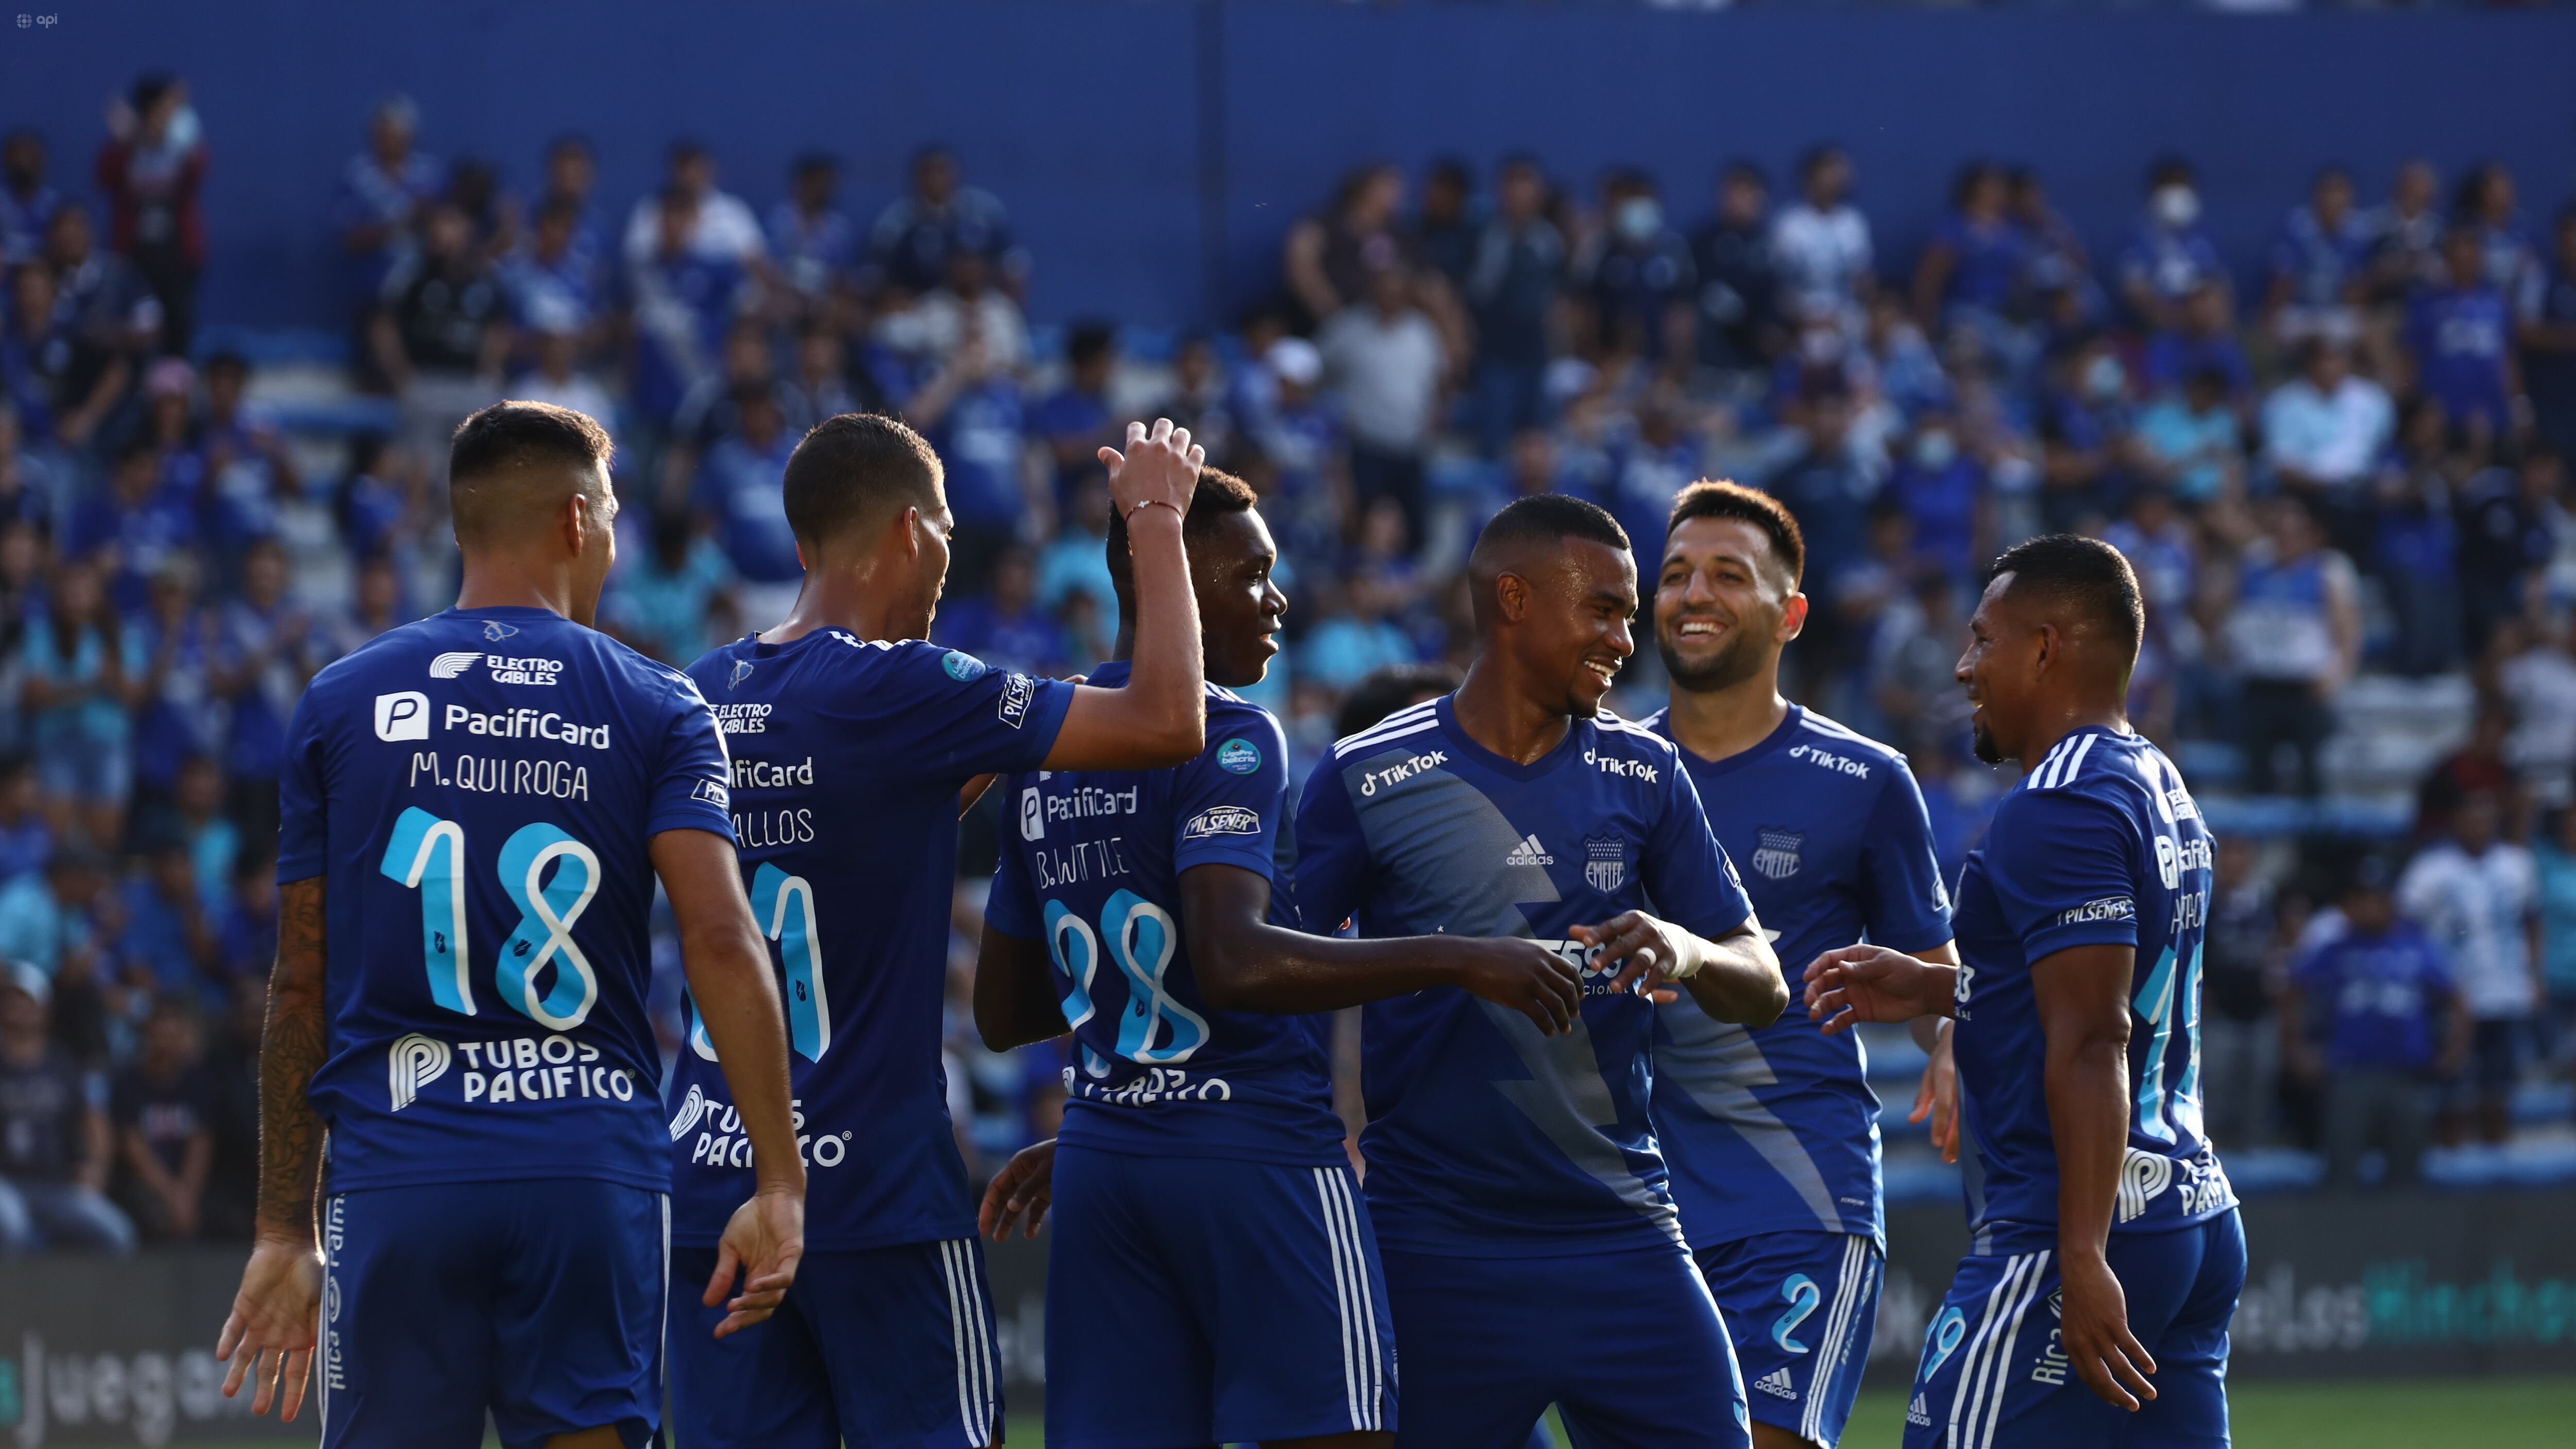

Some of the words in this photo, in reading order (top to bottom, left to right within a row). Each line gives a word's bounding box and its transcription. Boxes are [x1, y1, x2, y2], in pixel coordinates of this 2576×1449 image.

[486, 654, 564, 672] ELECTRO
[492, 669, 558, 686] CABLES
[445, 704, 610, 750] PacifiCard
[718, 703, 772, 719] ELECTRO
[730, 756, 814, 788] ifiCard
[1379, 750, 1449, 787] TikTok
[1597, 756, 1659, 784] TikTok
[1809, 748, 1871, 780] TikTok
[1047, 785, 1138, 823] PacifiCard
[732, 808, 815, 848] ALLOS
[1190, 813, 1252, 834] PILSENER
[1506, 853, 1554, 866] adidas
[1753, 847, 1801, 880] EMELEC
[1585, 861, 1624, 894] EMELEC
[380, 806, 601, 1031] 18
[1043, 888, 1210, 1078] 28
[458, 1035, 600, 1070] TUBOS
[464, 1065, 634, 1104] PACIFICO
[704, 1099, 805, 1134] TUS
[692, 1132, 845, 1168] PACICO
[1772, 1272, 1821, 1354] 2
[1754, 1380, 1798, 1400] adidas
